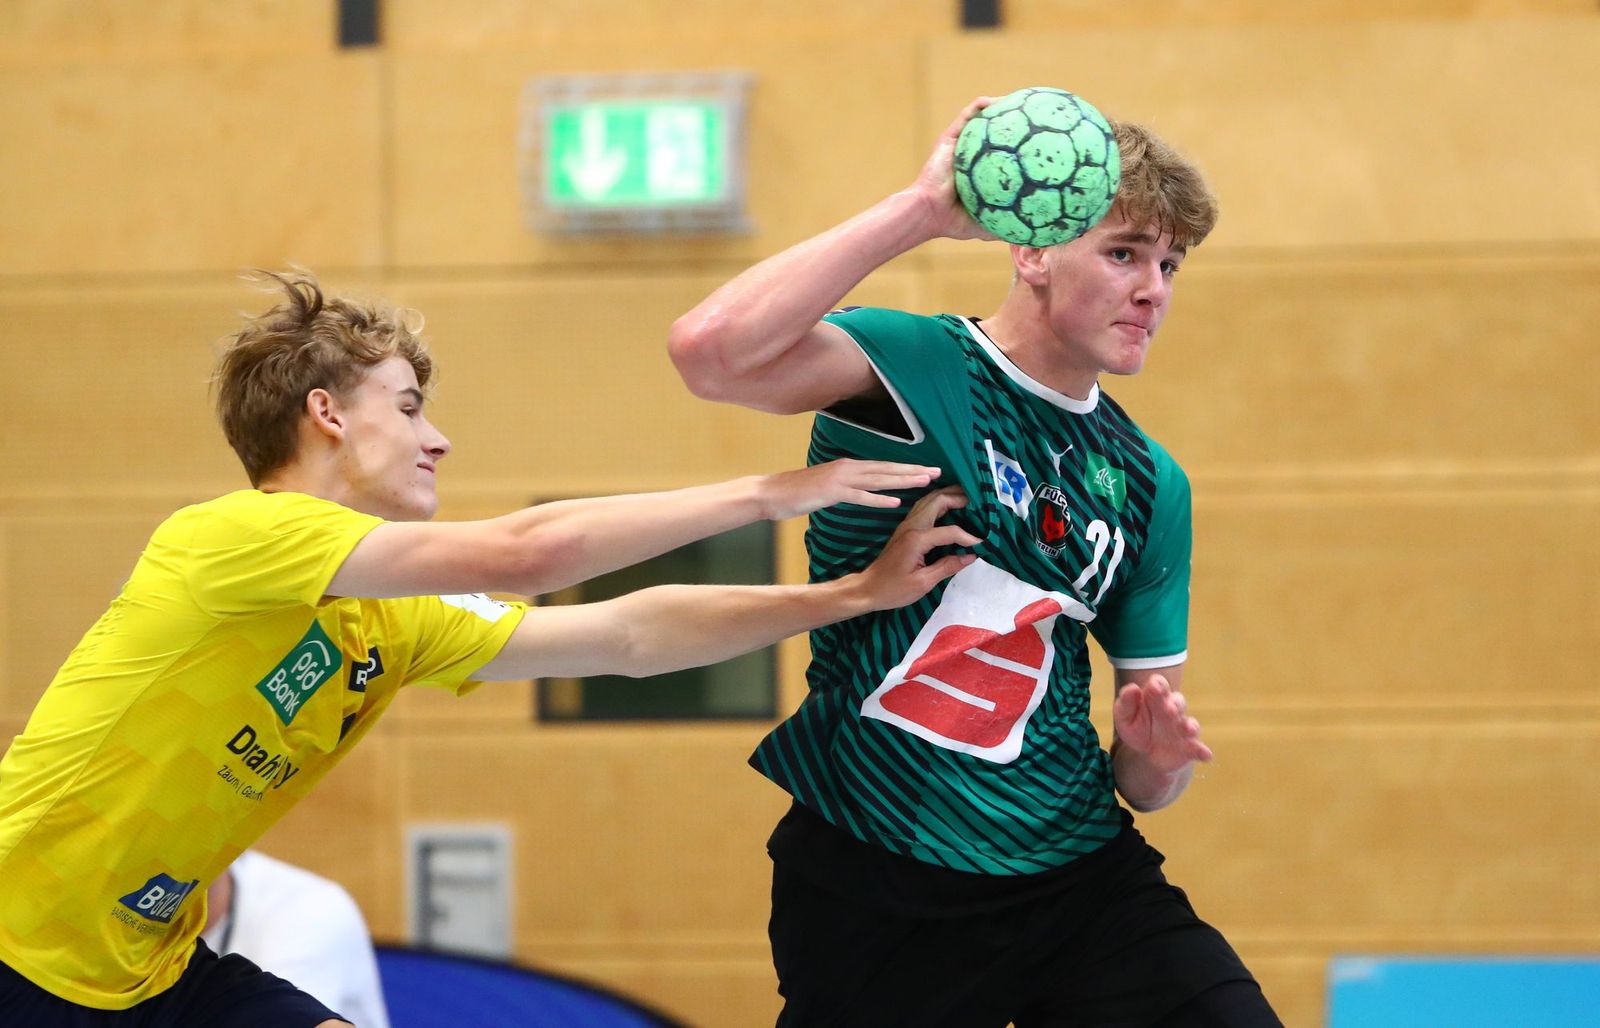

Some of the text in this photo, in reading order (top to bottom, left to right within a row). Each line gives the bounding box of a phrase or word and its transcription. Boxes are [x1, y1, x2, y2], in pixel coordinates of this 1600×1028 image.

[1072, 519, 1125, 606] 21
[266, 667, 300, 717] Bank
[291, 652, 326, 691] psd
